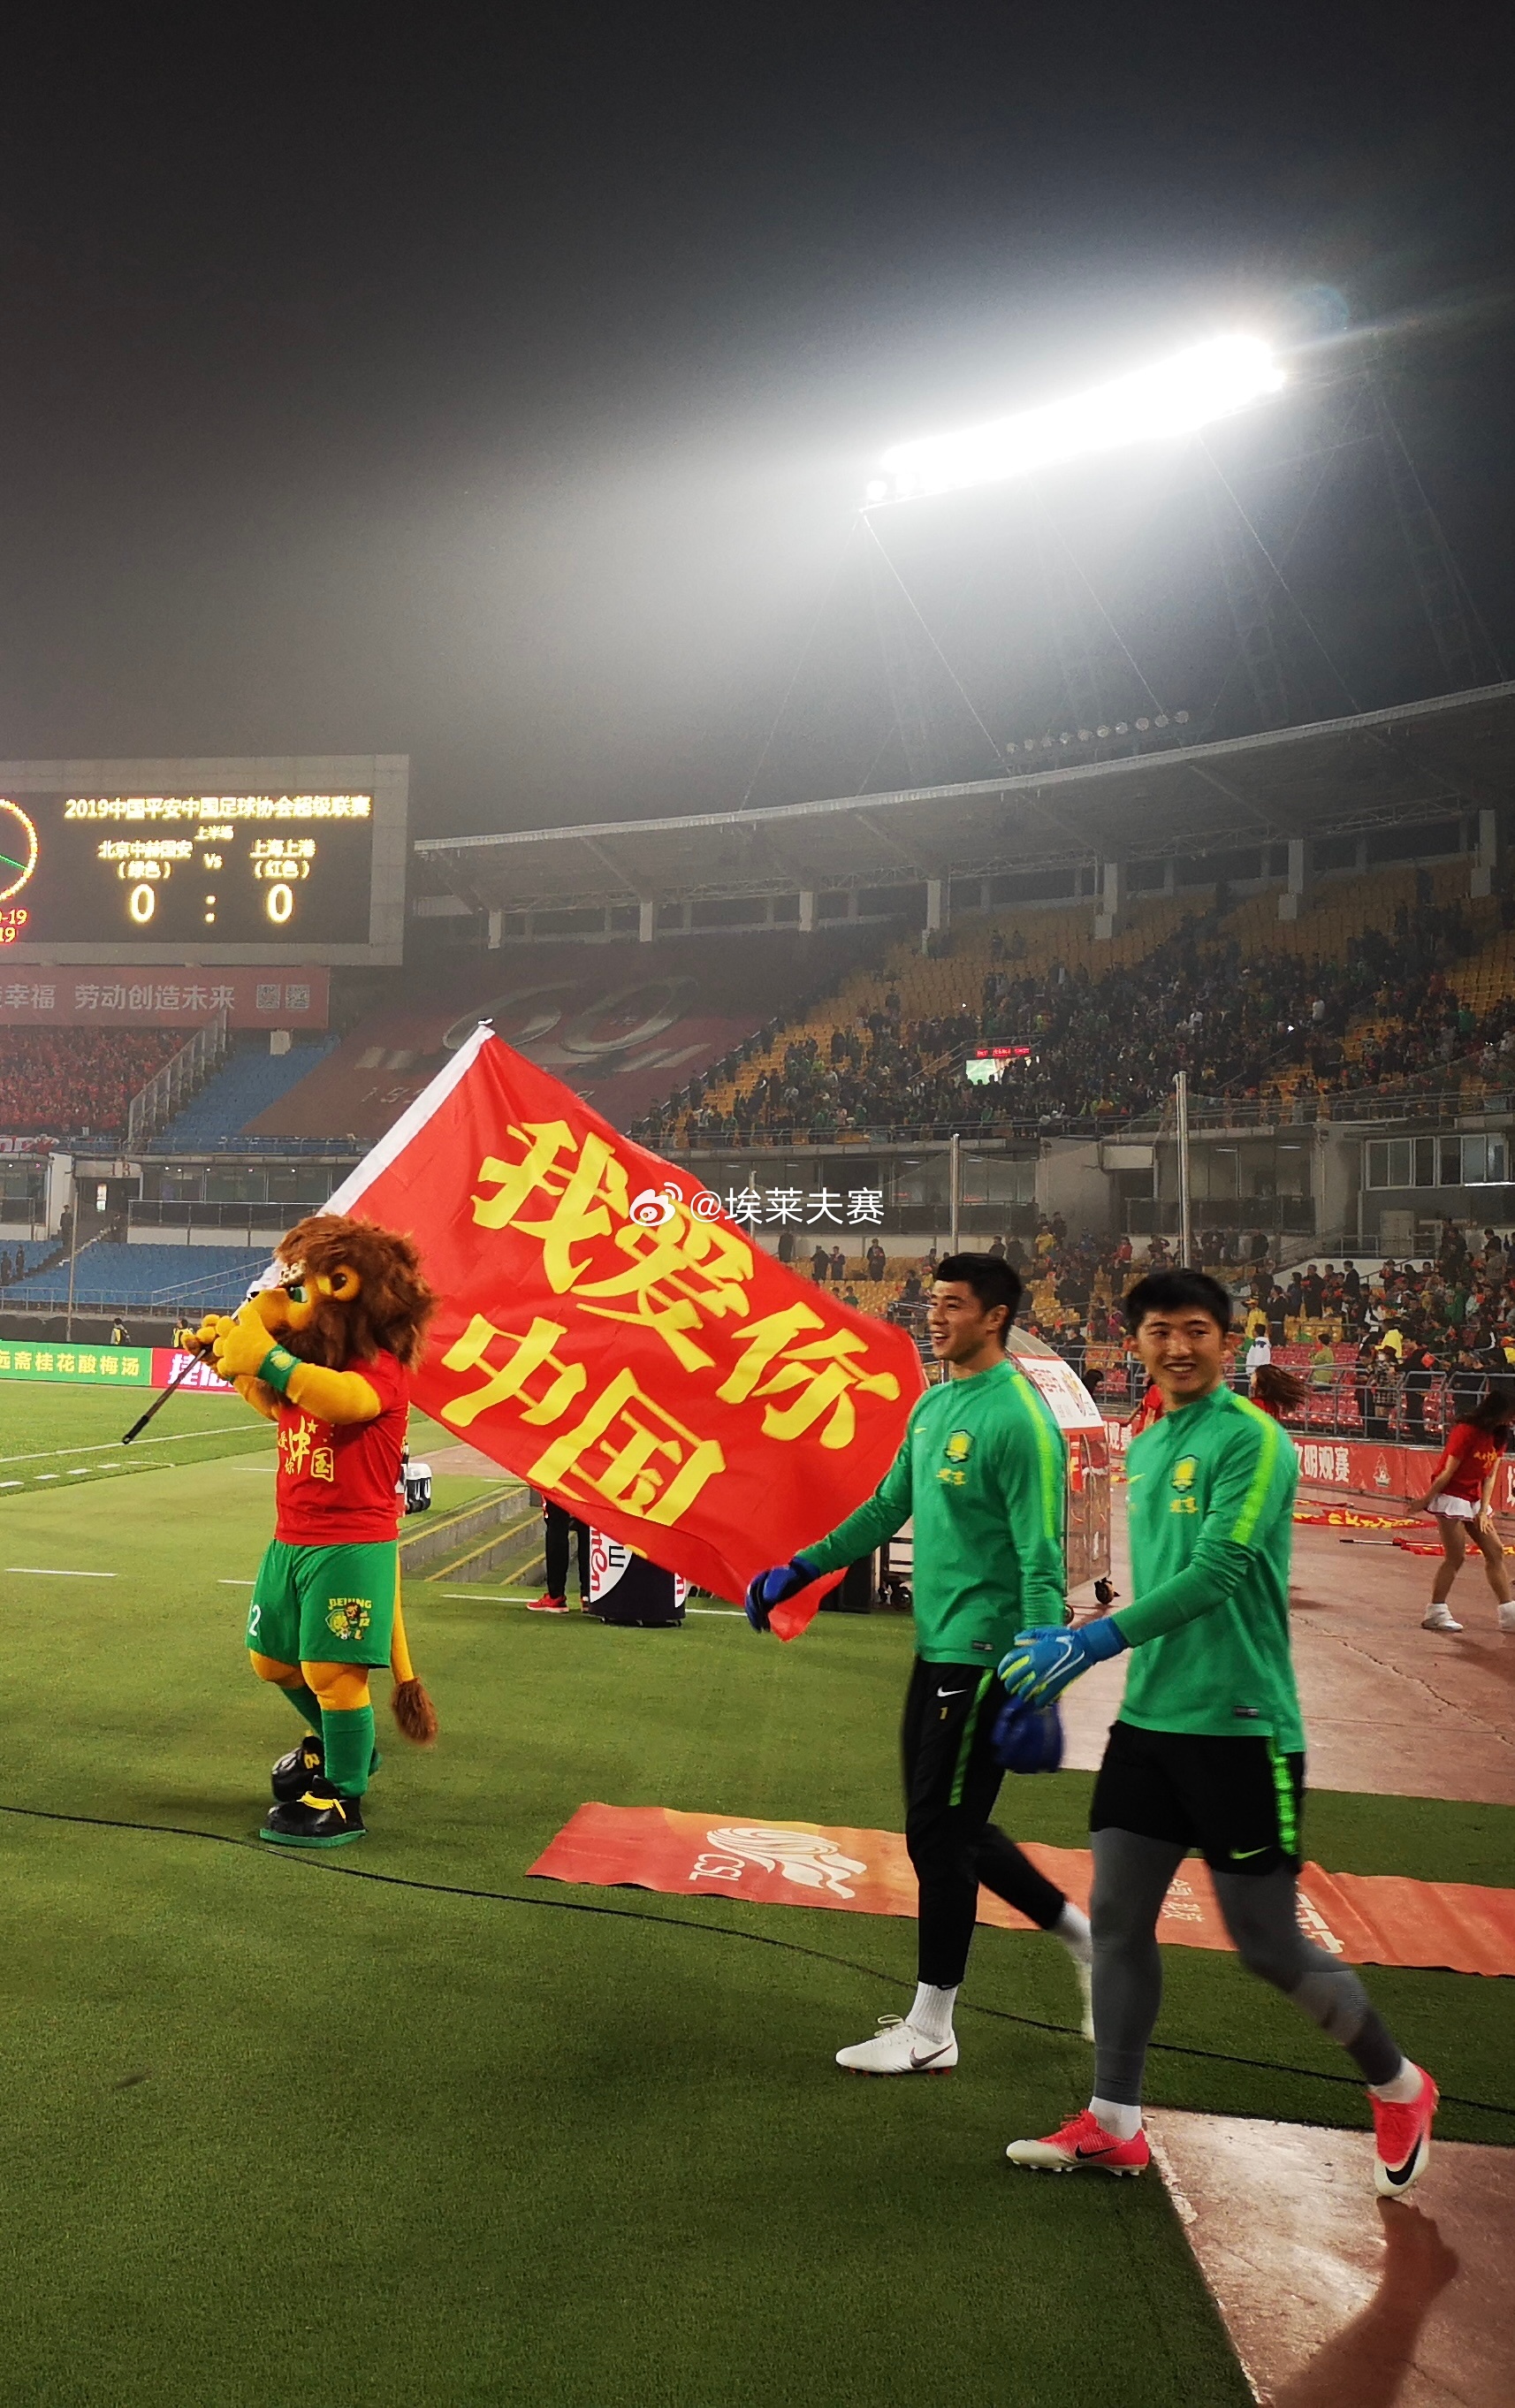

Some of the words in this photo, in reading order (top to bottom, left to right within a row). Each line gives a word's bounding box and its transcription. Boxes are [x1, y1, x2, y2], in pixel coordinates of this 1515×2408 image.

[65, 796, 371, 819] 2019中国平安中国足球协会超级联赛
[194, 825, 234, 841] 上半场
[249, 839, 316, 859] 上海上港
[130, 884, 156, 923] 0
[268, 884, 293, 924] 0
[0, 909, 27, 926] -19
[0, 983, 57, 1009] 幸福
[74, 984, 235, 1012] 劳动创造未来
[441, 1314, 727, 1527] 中国
[940, 1706, 949, 1720] 1
[689, 1853, 746, 1881] CSL
